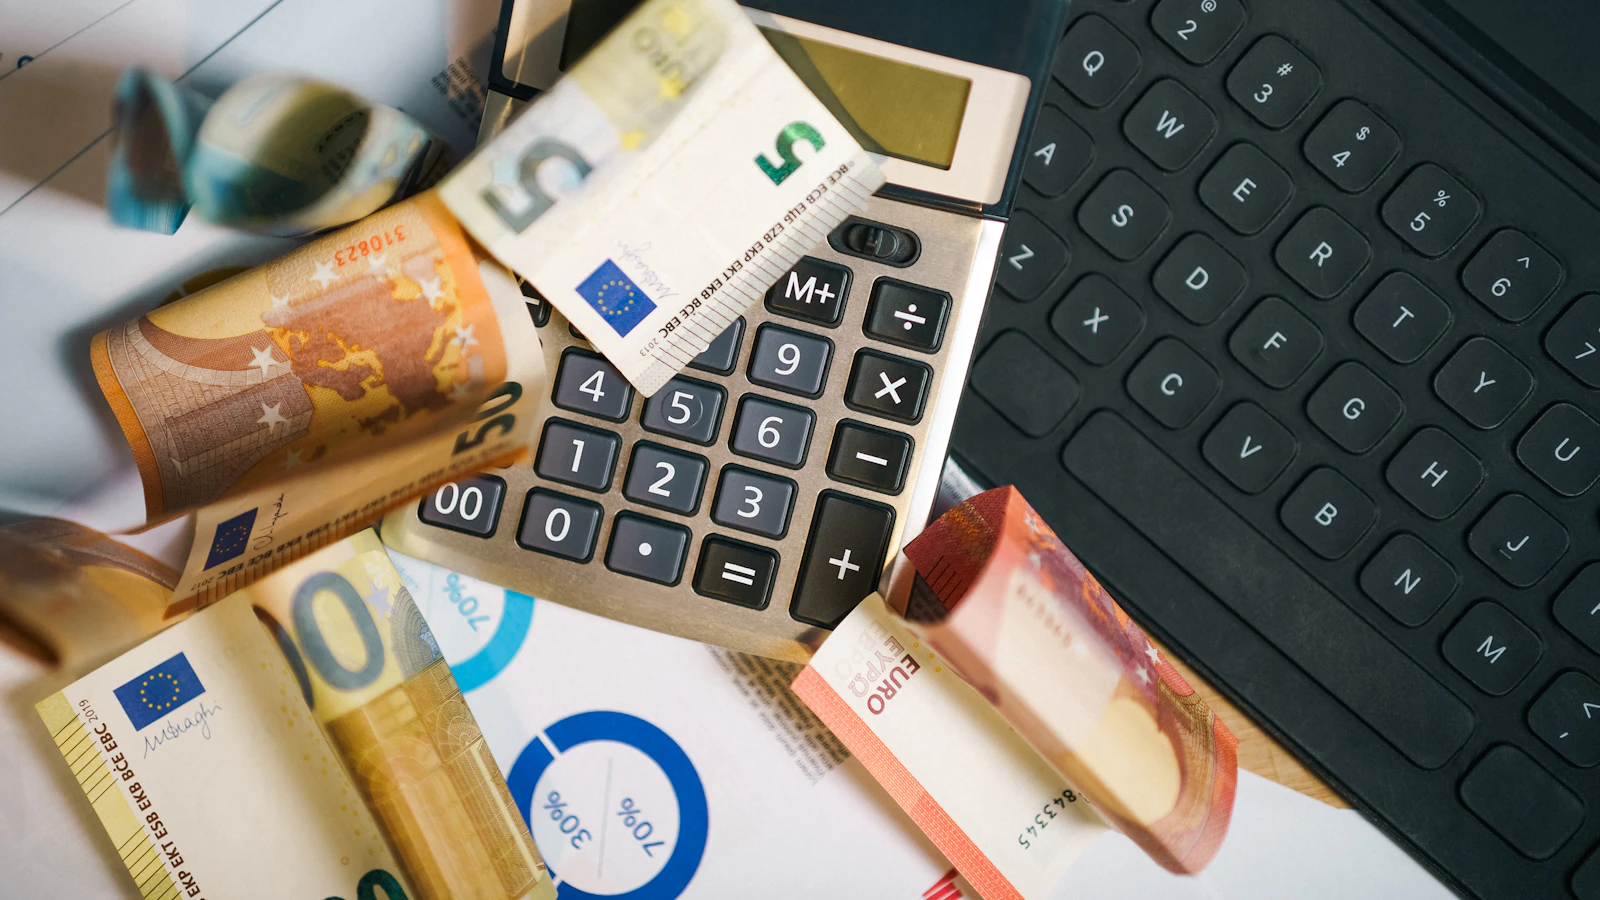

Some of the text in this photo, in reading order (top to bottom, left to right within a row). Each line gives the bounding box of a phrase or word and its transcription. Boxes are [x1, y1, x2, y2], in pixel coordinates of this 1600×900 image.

[1176, 19, 1198, 41] 2
[1082, 50, 1105, 77] Q
[1253, 83, 1274, 104] 3
[1156, 109, 1185, 139] W
[1355, 124, 1371, 142] $
[754, 120, 826, 186] 5
[1034, 142, 1057, 166] A
[1332, 149, 1352, 169] 4
[479, 135, 592, 235] 5
[804, 182, 827, 204] ECB
[1232, 177, 1257, 203] E
[1432, 189, 1451, 208] %
[1111, 204, 1134, 228] S
[1409, 211, 1432, 232] 5
[761, 221, 785, 243] EZB
[334, 224, 407, 267] 310823
[740, 240, 764, 262] EKP
[1009, 244, 1035, 270] Z
[1309, 241, 1333, 268] R
[720, 258, 743, 281] EKT
[1185, 266, 1209, 291] D
[699, 277, 723, 300] EKB
[784, 271, 836, 304] M+
[1491, 277, 1512, 297] 6
[657, 315, 681, 338] EBC
[1083, 306, 1110, 334] X
[1392, 305, 1415, 328] T
[637, 336, 659, 357] 2013
[1262, 331, 1288, 355] F
[1574, 341, 1597, 360] 7
[774, 343, 801, 376] 9
[578, 370, 605, 403] 4
[1160, 372, 1183, 396] C
[1473, 370, 1496, 394] Y
[451, 382, 523, 456] 50
[667, 390, 695, 425] 5
[1342, 397, 1366, 420] G
[757, 416, 784, 449] 6
[571, 438, 585, 473] 1
[1240, 435, 1263, 459] V
[1554, 437, 1581, 462] U
[647, 461, 676, 498] 2
[1420, 460, 1449, 488] H
[434, 482, 483, 521] 00
[736, 485, 764, 519] 3
[1314, 501, 1338, 526] B
[544, 507, 571, 542] 0
[1506, 533, 1530, 553] J
[215, 562, 245, 579] EBC
[1394, 568, 1422, 595] N
[442, 573, 491, 632] 70%
[1476, 635, 1507, 664] M
[867, 653, 921, 716] EURO
[77, 697, 99, 723] 2019
[92, 721, 118, 752] EBC
[126, 780, 152, 811] EKB
[144, 810, 168, 840] ESB
[543, 791, 593, 850] 30%
[616, 798, 665, 857] 70%
[1018, 789, 1077, 850] 843345
[160, 839, 185, 869] EKT
[176, 867, 201, 898] EKP
